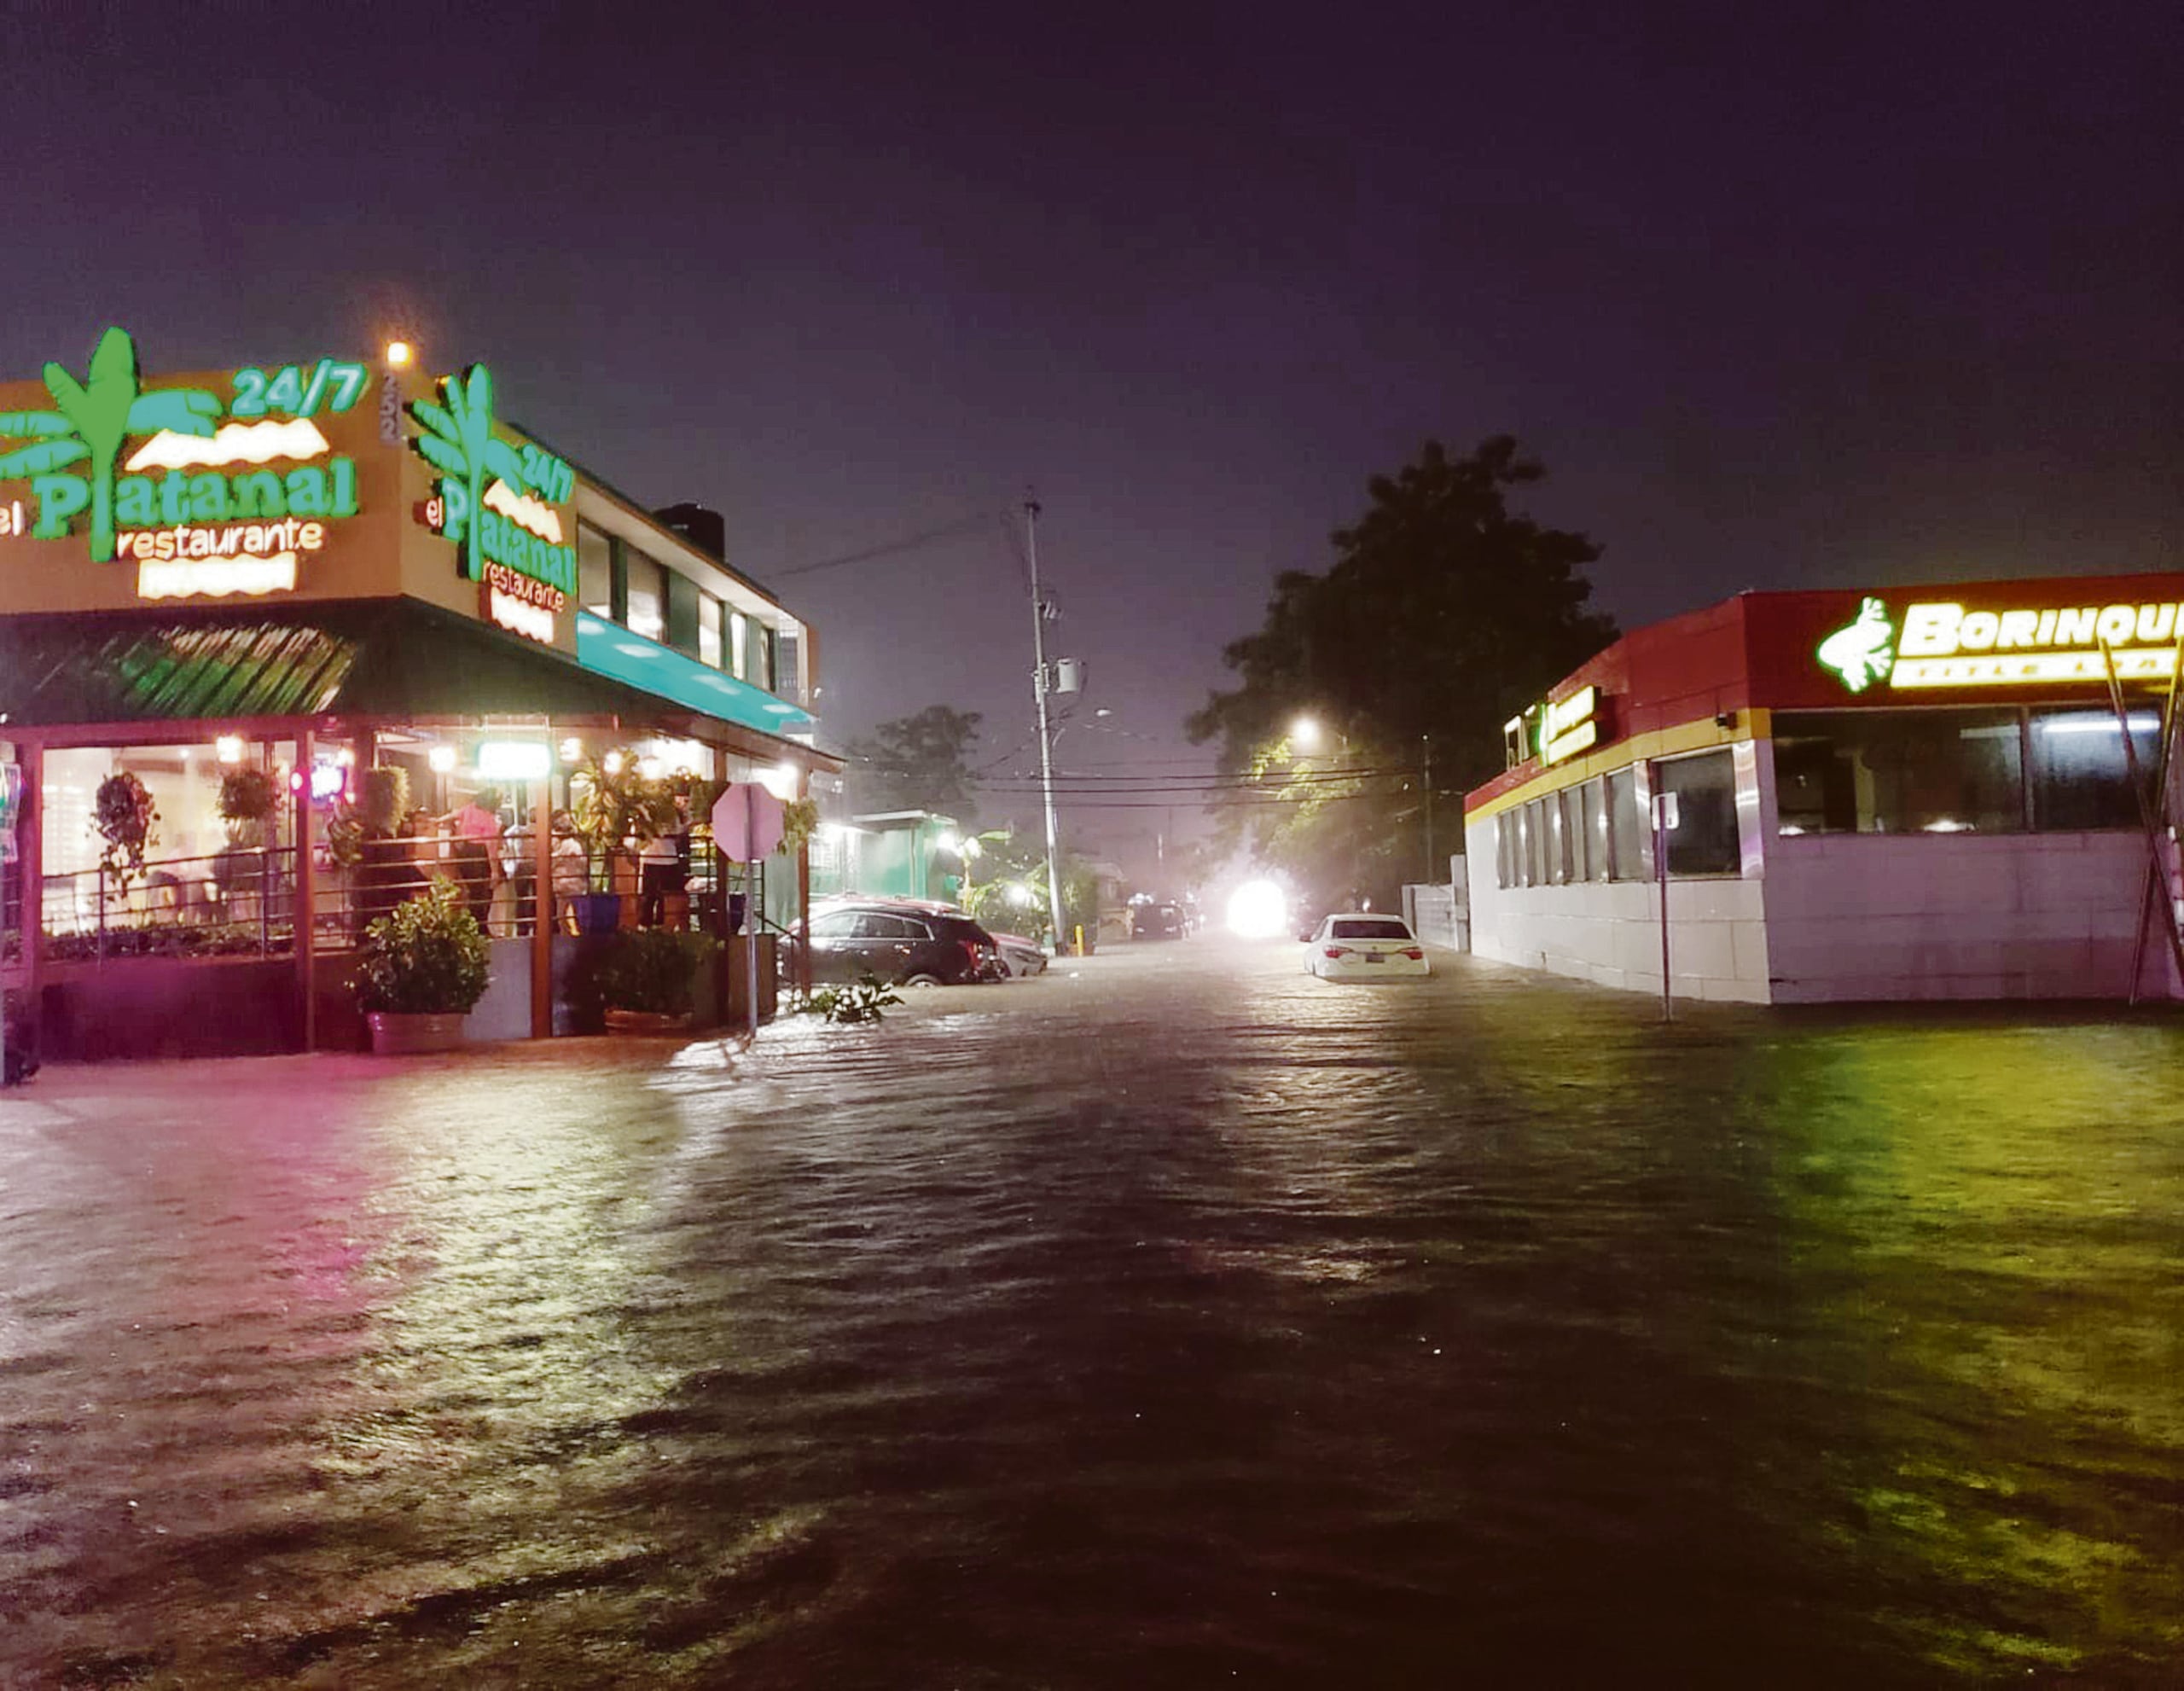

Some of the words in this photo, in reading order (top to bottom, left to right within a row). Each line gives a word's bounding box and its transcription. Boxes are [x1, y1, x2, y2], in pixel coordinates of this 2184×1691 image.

[231, 357, 367, 417] 24/7
[522, 444, 574, 504] 24/7
[32, 456, 358, 563] Platanal
[117, 517, 322, 560] restaurante
[426, 497, 443, 529] el
[441, 475, 578, 596] Platanal
[482, 560, 564, 612] restaurante
